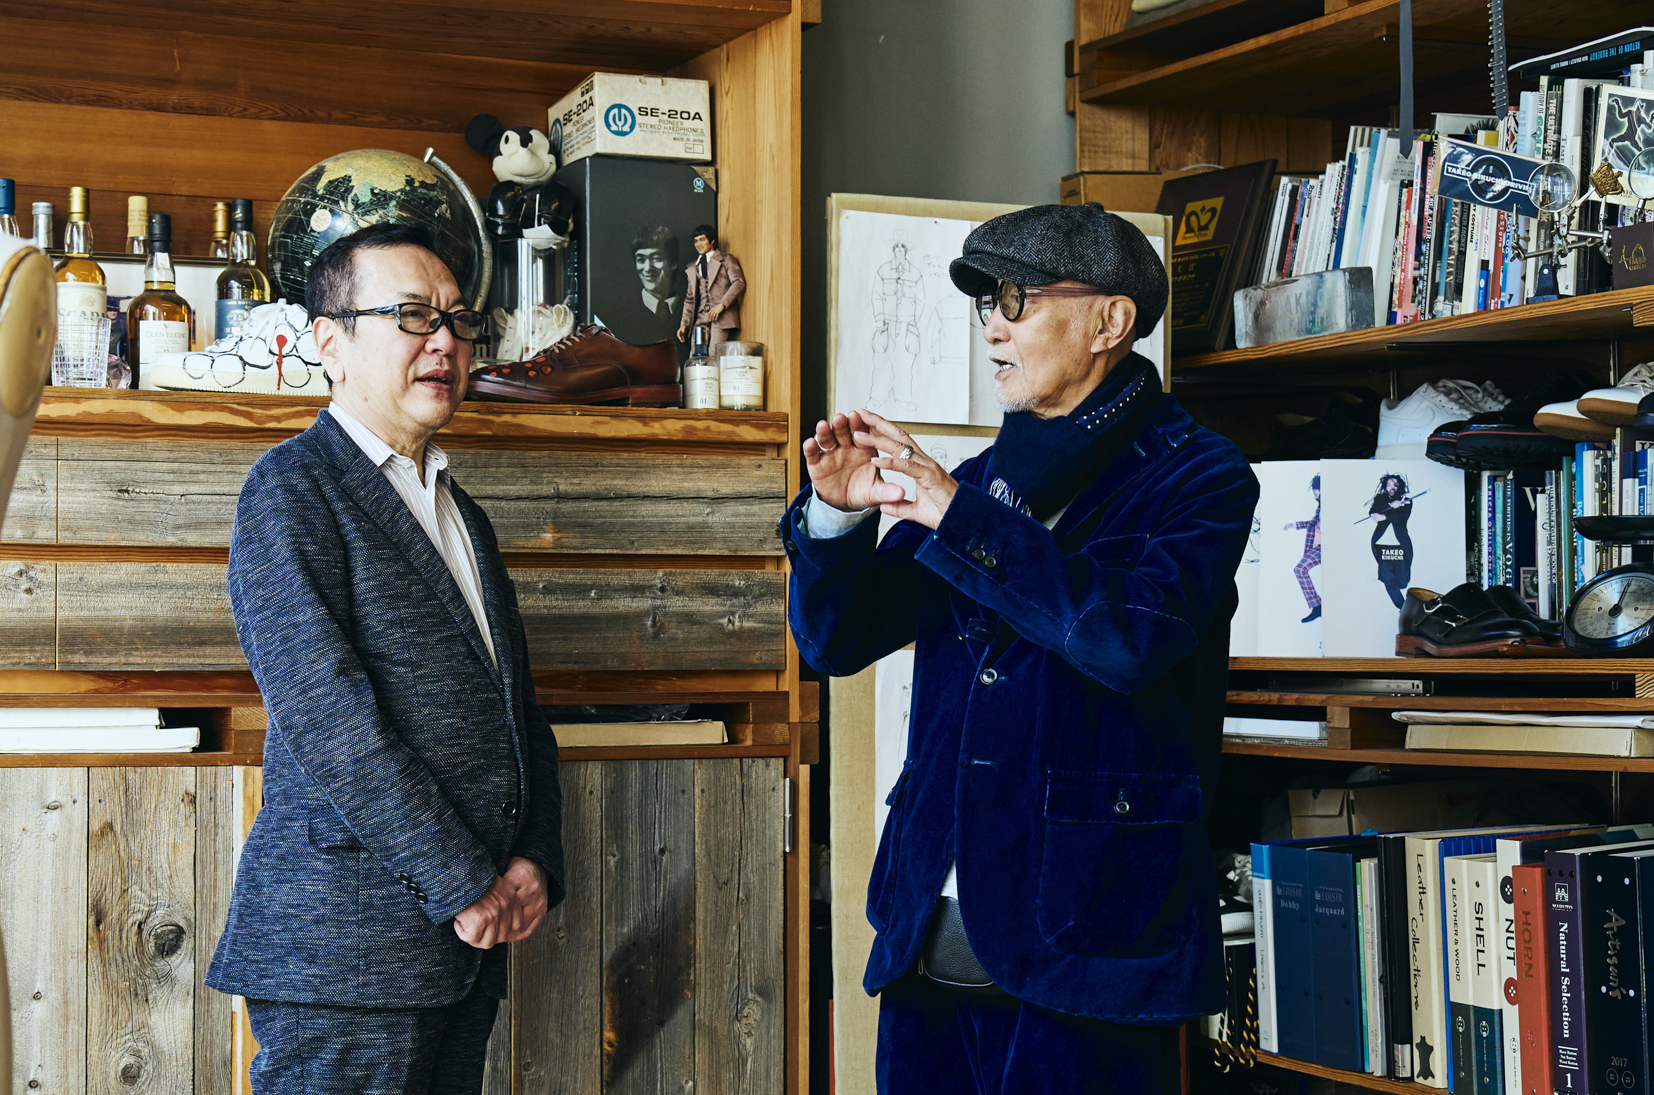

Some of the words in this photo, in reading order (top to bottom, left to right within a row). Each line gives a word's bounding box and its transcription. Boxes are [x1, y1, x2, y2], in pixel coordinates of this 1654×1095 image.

[563, 96, 594, 127] SE-20A
[638, 106, 703, 122] SE-20A
[1548, 98, 1557, 114] THE
[638, 122, 662, 131] STEREO
[1534, 115, 1544, 155] GOLF
[1544, 115, 1556, 155] ULTIMATE
[1448, 199, 1460, 251] LEGANT
[1461, 203, 1469, 226] ATHER
[1445, 255, 1455, 284] MAN
[166, 331, 186, 339] ELGIN
[699, 397, 708, 405] 01
[1506, 532, 1512, 542] IN
[1415, 853, 1424, 923] Leather
[1280, 899, 1300, 911] Dobby
[1315, 904, 1345, 916] Jacquard
[1454, 938, 1459, 946] &
[1474, 900, 1487, 976] SHELL
[1504, 917, 1517, 967] NUT
[1521, 910, 1534, 979] HORN
[1557, 921, 1571, 972] Natural
[1410, 917, 1420, 1011] Collections
[1560, 976, 1572, 1039] Selection
[1611, 1055, 1628, 1067] 2017
[1565, 1072, 1573, 1088] 1
